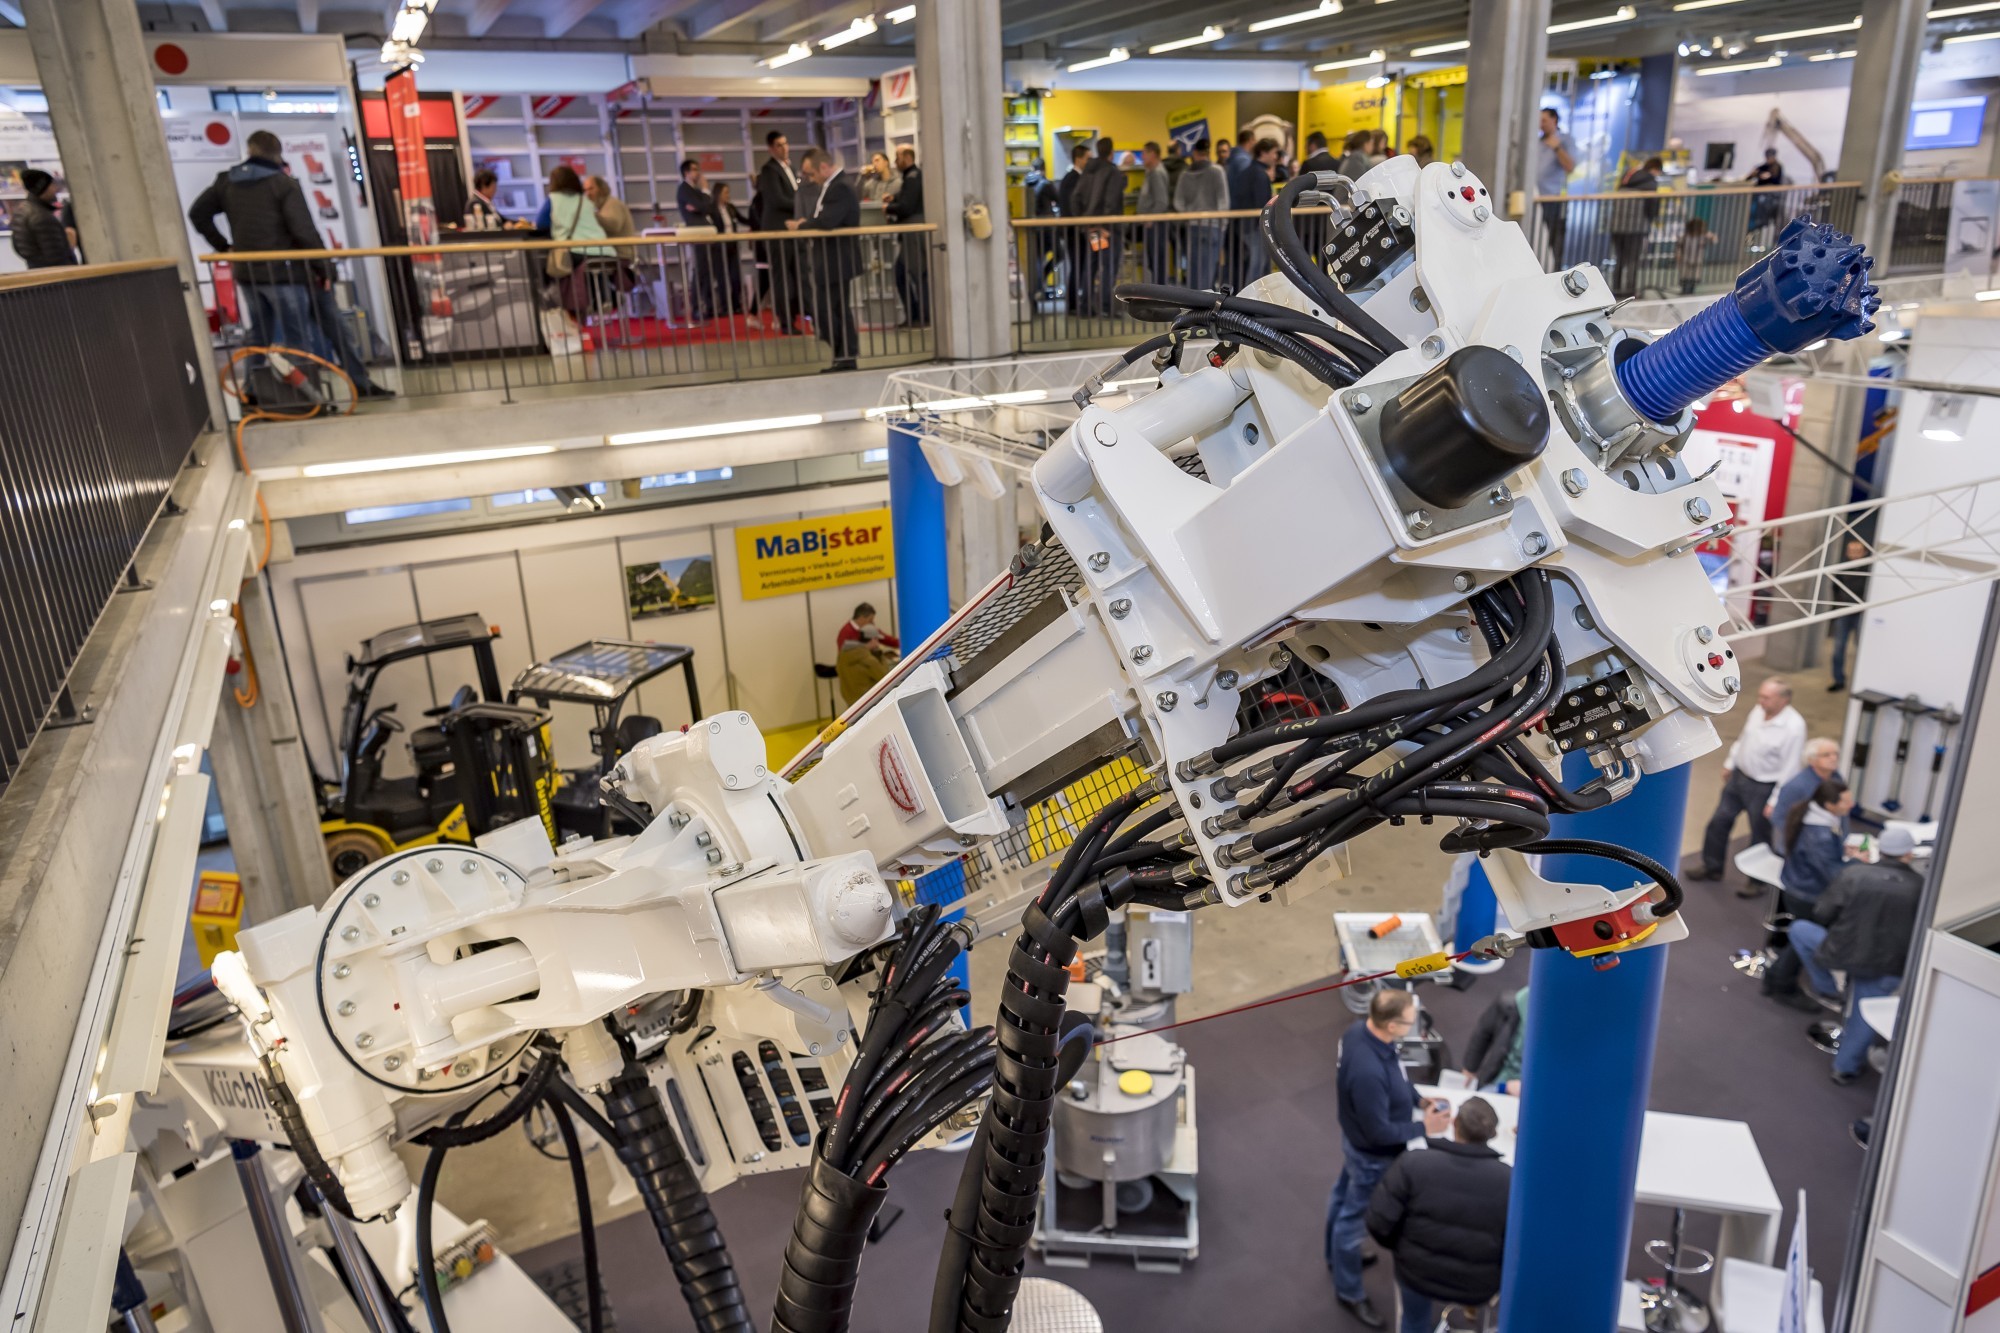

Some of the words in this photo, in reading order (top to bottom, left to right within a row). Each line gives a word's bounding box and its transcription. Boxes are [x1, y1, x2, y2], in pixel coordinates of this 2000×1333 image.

[755, 526, 882, 560] MaBistar
[759, 566, 806, 578] Vermietung
[812, 559, 844, 571] Verkauf
[850, 554, 884, 564] Schulung
[761, 574, 823, 590] Arbeitsbühnen
[834, 565, 885, 579] Gabelstapler
[203, 1069, 266, 1110] Küchl
